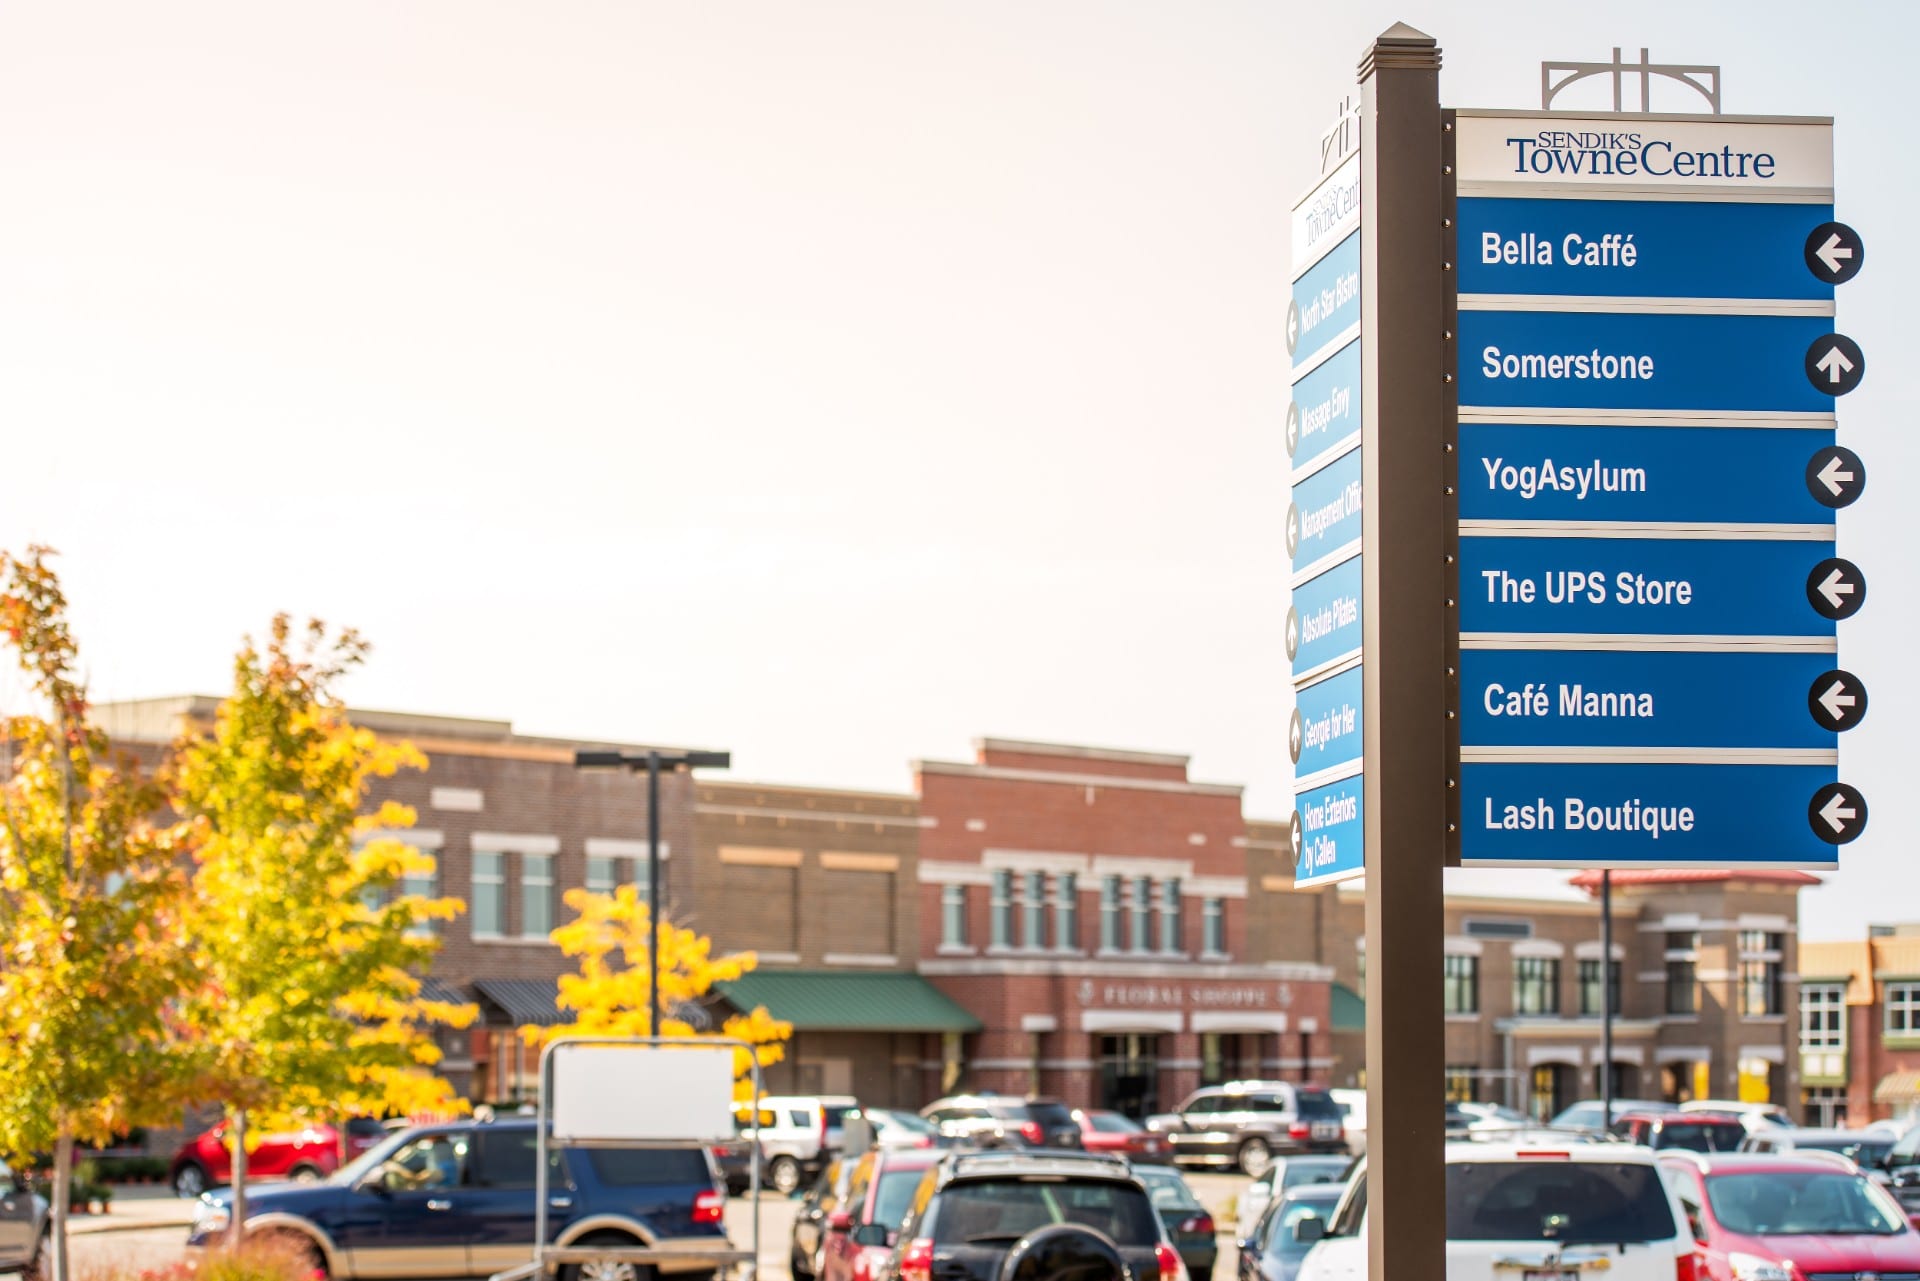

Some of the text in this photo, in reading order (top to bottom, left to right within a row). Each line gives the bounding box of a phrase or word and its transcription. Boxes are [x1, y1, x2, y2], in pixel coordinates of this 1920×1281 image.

[1538, 131, 1642, 150] SENDIK'S
[1482, 231, 1637, 267] Bella Caffé
[1301, 271, 1358, 336] North Star Bistro
[1482, 346, 1654, 380] Somerstone
[1301, 384, 1350, 438] Massage Envy
[1481, 457, 1646, 500] YogAsylum
[1301, 508, 1345, 540] Management
[1481, 570, 1692, 605] The UPS Store
[1302, 595, 1357, 645] Absolute Pilates
[1484, 683, 1654, 718] Café Manna
[1304, 703, 1356, 752] Georgie for Her
[1304, 791, 1357, 833] Home Exteriors
[1485, 797, 1695, 839] Lash Boutique
[1305, 834, 1336, 877] by Callen
[1103, 985, 1183, 1005] FLORAL
